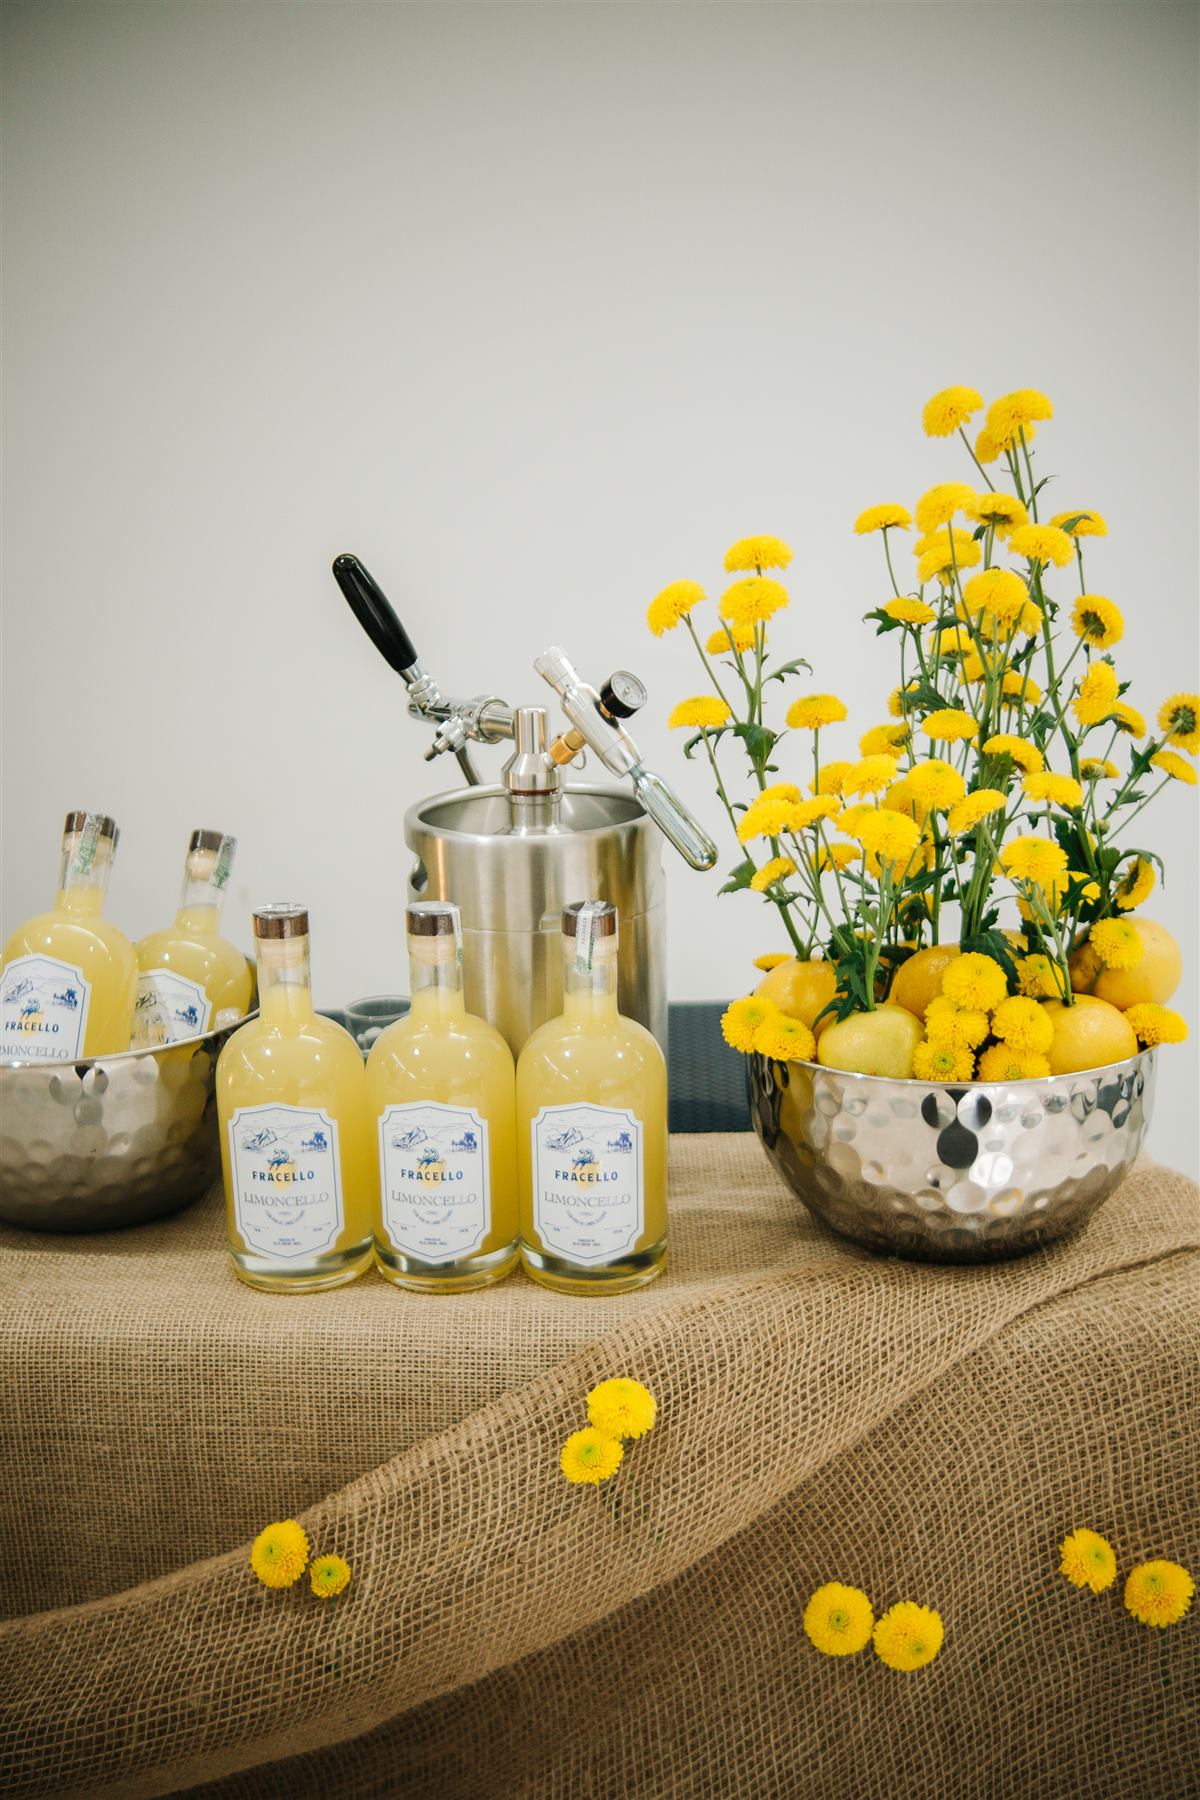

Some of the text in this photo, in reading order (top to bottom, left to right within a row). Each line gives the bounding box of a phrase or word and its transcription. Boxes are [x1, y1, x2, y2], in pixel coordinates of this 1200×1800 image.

[5, 1021, 60, 1033] FRACELLO
[252, 1170, 315, 1182] FRACELLO
[401, 1169, 464, 1181] FRACELLO
[555, 1170, 618, 1182] FRACELLO
[244, 1191, 330, 1207] LIMONCELLO
[391, 1190, 477, 1207] LIMONCELLO
[544, 1191, 632, 1208] LIMONCELLO
